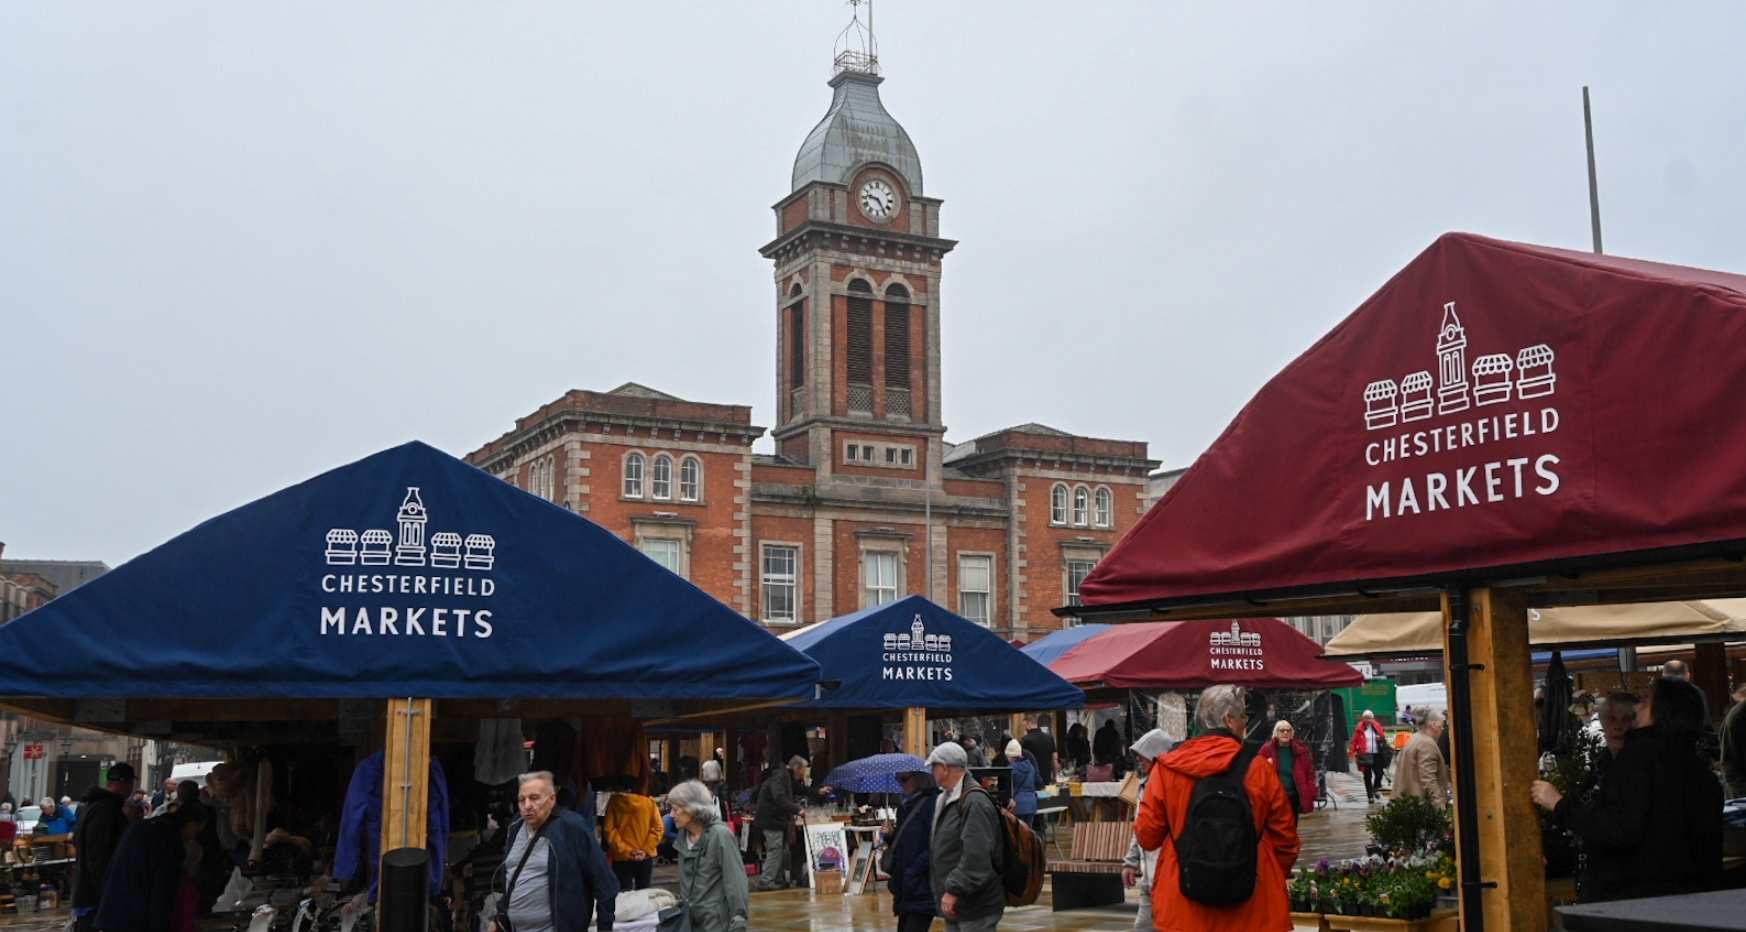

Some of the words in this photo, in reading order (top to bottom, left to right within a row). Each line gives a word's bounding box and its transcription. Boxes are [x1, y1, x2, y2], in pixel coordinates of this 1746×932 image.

[1365, 407, 1560, 466] CHESTERFIELD
[1366, 454, 1561, 521] MARKETS
[321, 574, 495, 596] CHESTERFIELD
[320, 606, 494, 638] MARKETS
[883, 653, 952, 663] CHESTERFIELD
[1210, 647, 1263, 656] CHESTERFIELD
[1211, 658, 1264, 670] MARKETS
[883, 667, 953, 681] MARKETS
